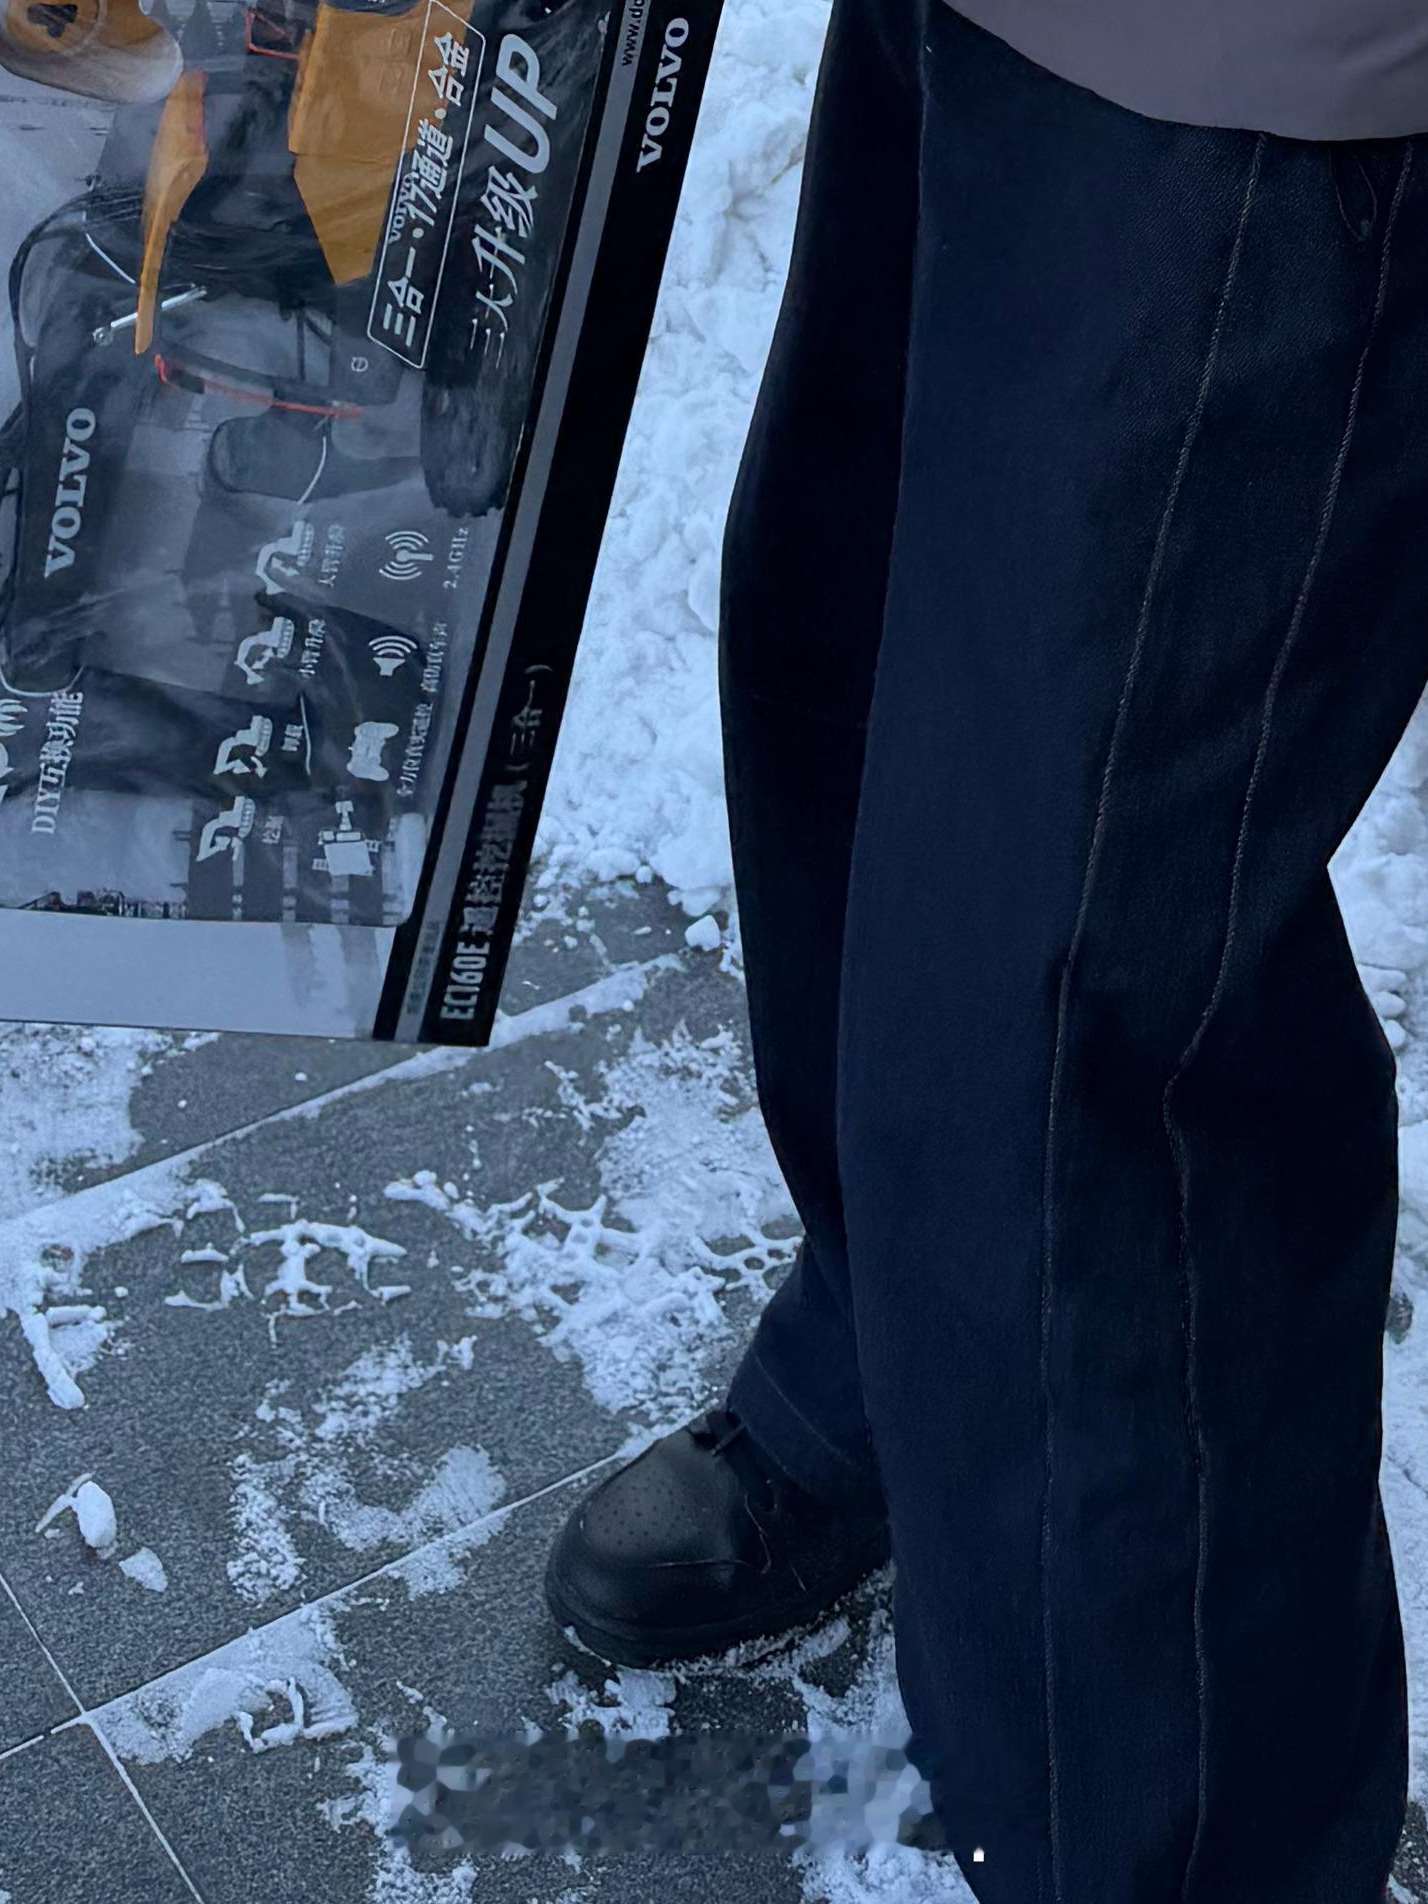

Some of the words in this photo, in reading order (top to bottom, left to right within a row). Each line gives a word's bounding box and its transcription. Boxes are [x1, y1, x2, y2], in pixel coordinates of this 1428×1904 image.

[637, 18, 690, 173] VOLVO
[43, 407, 96, 579] VOLVO
[444, 527, 470, 589] 2.4GHz
[440, 938, 490, 1022] EC160E
